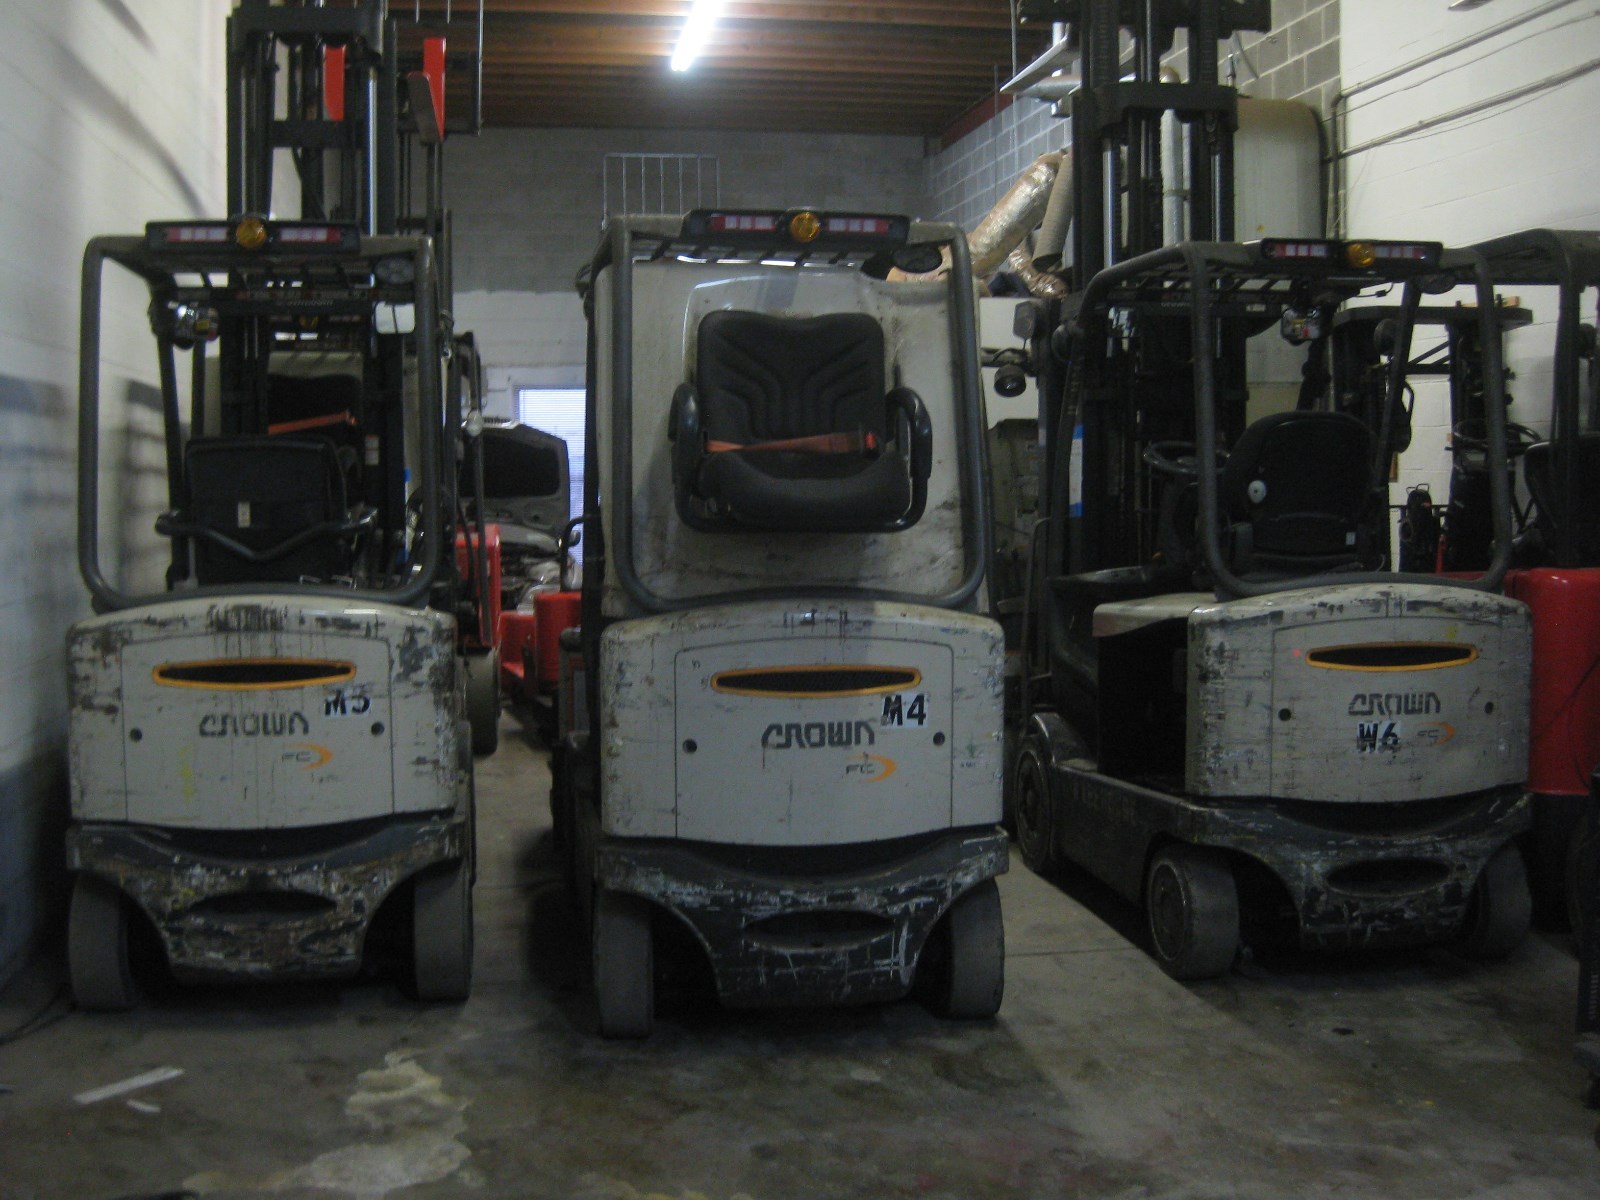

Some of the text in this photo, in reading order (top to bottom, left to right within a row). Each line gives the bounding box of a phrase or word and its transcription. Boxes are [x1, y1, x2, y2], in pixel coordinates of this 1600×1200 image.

[881, 695, 927, 726] M4
[1348, 692, 1442, 716] CROWN
[199, 712, 309, 738] CROWN
[761, 720, 875, 750] CROWN
